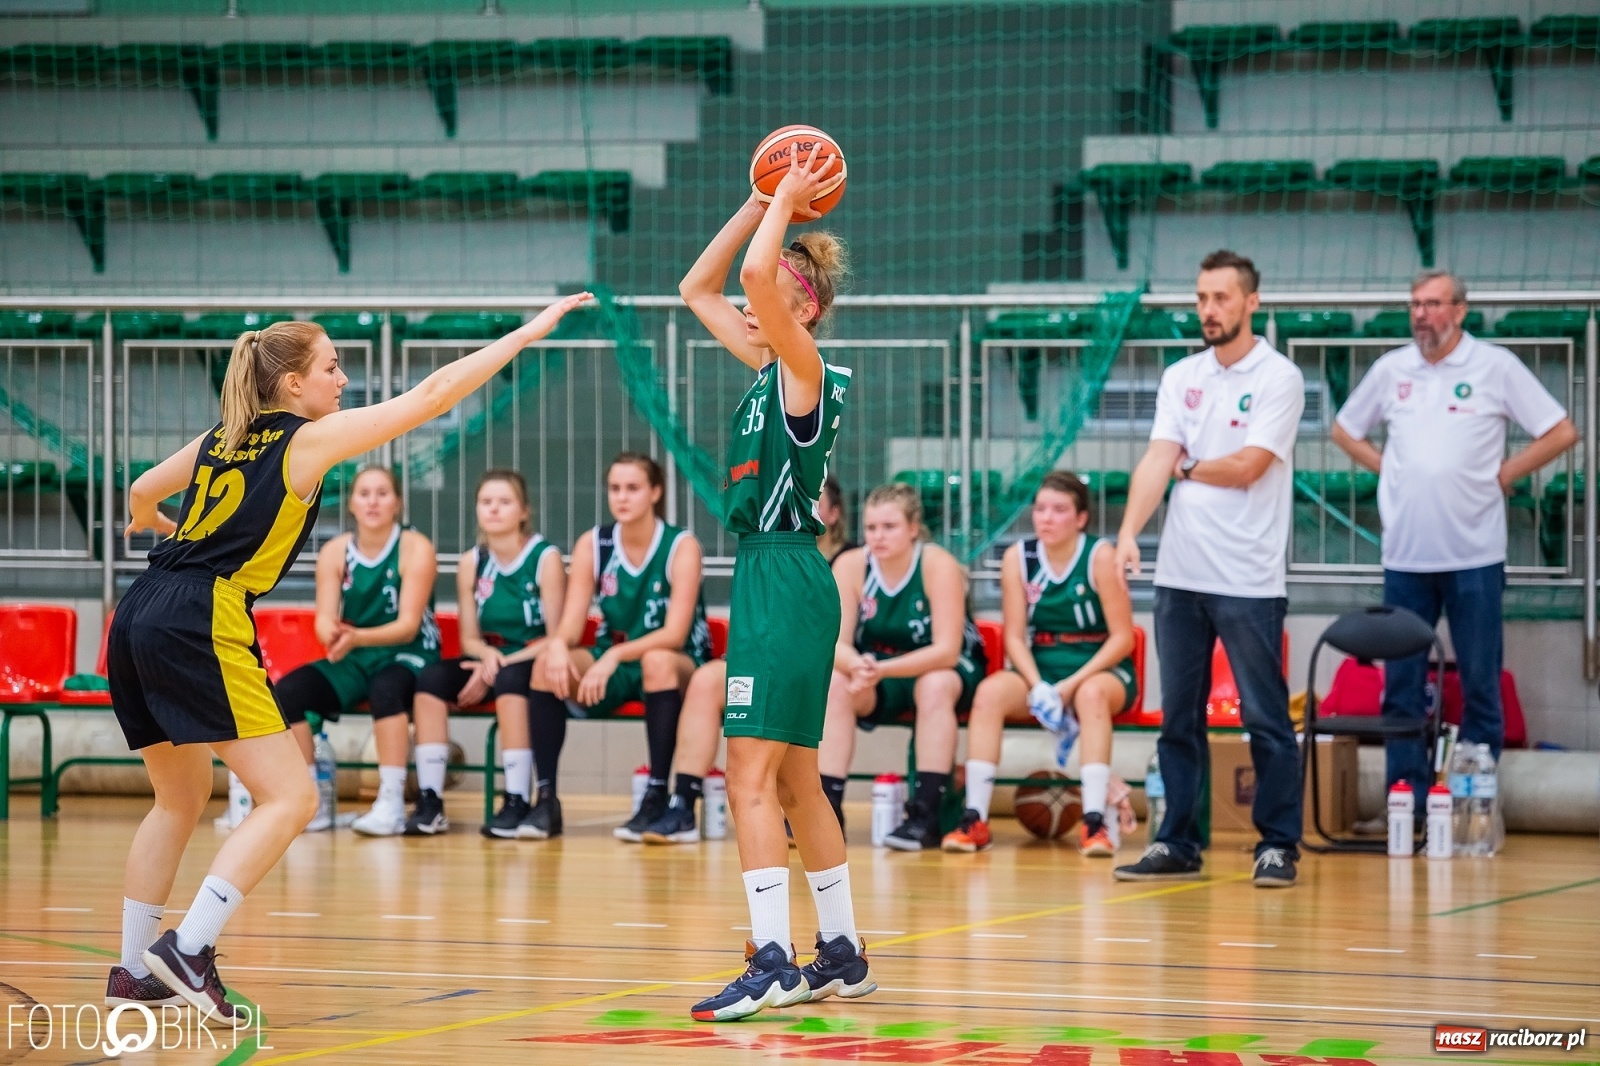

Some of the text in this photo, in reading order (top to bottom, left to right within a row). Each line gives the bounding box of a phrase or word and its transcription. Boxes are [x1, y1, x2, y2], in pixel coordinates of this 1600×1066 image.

[768, 141, 823, 164] mote
[742, 395, 766, 435] 35
[177, 465, 245, 541] 12
[382, 584, 398, 614] 3
[1073, 599, 1097, 630] 11
